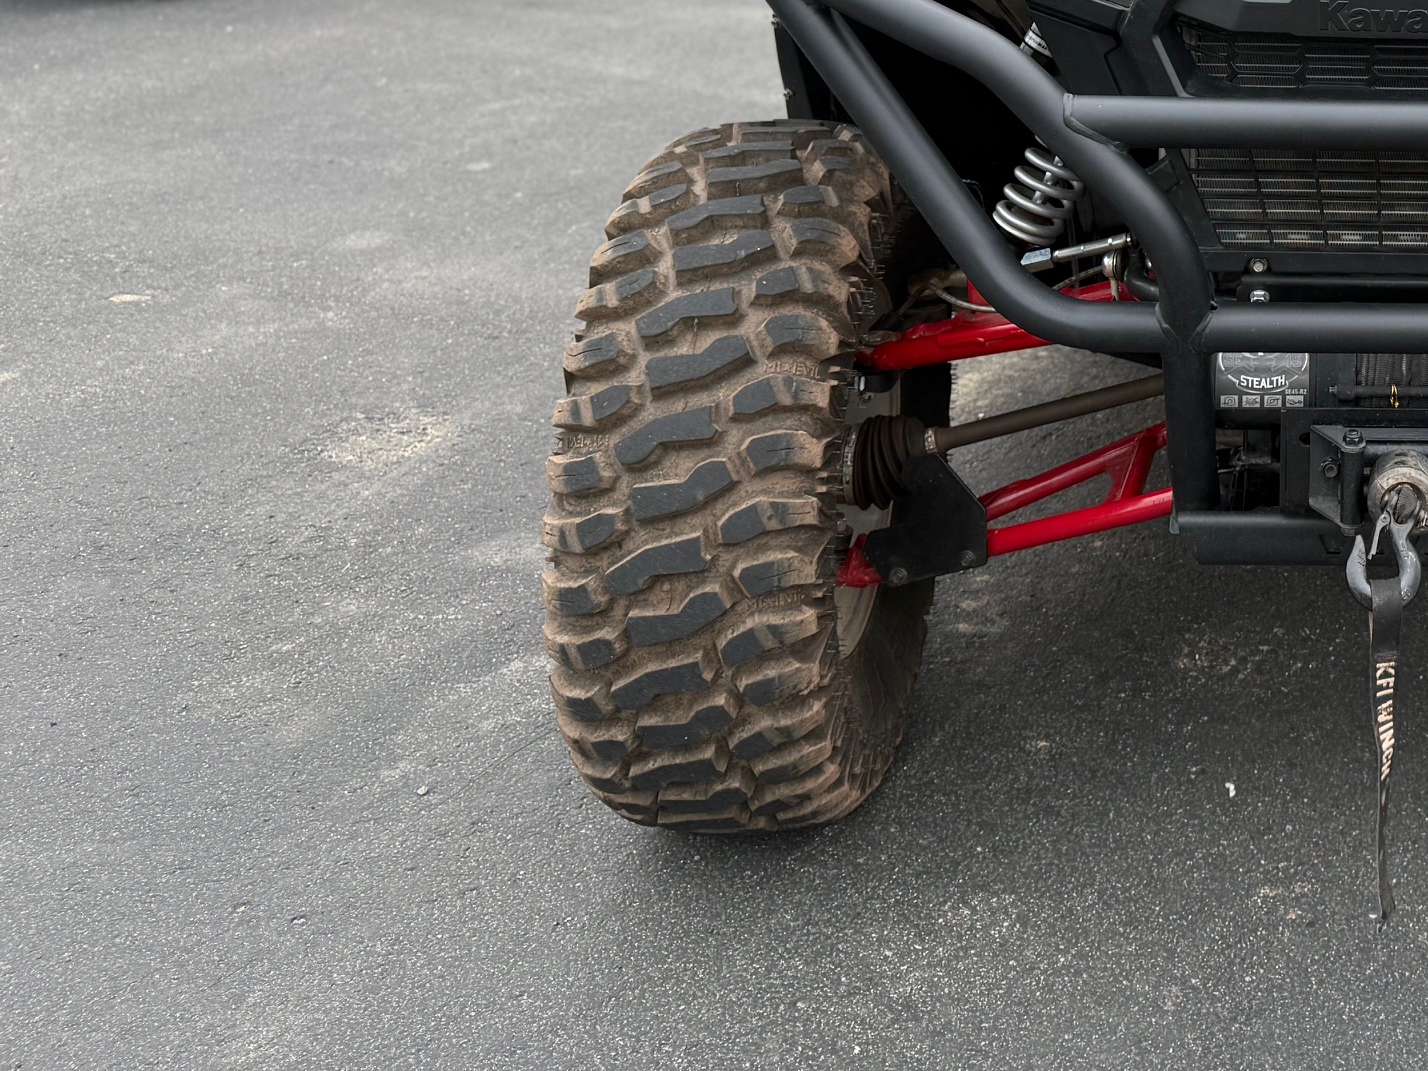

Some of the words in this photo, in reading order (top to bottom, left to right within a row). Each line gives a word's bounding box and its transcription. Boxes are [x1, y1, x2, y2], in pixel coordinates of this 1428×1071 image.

[1240, 374, 1286, 389] STEALTH
[1376, 661, 1396, 698] KFI
[1377, 699, 1395, 781] WINCH
